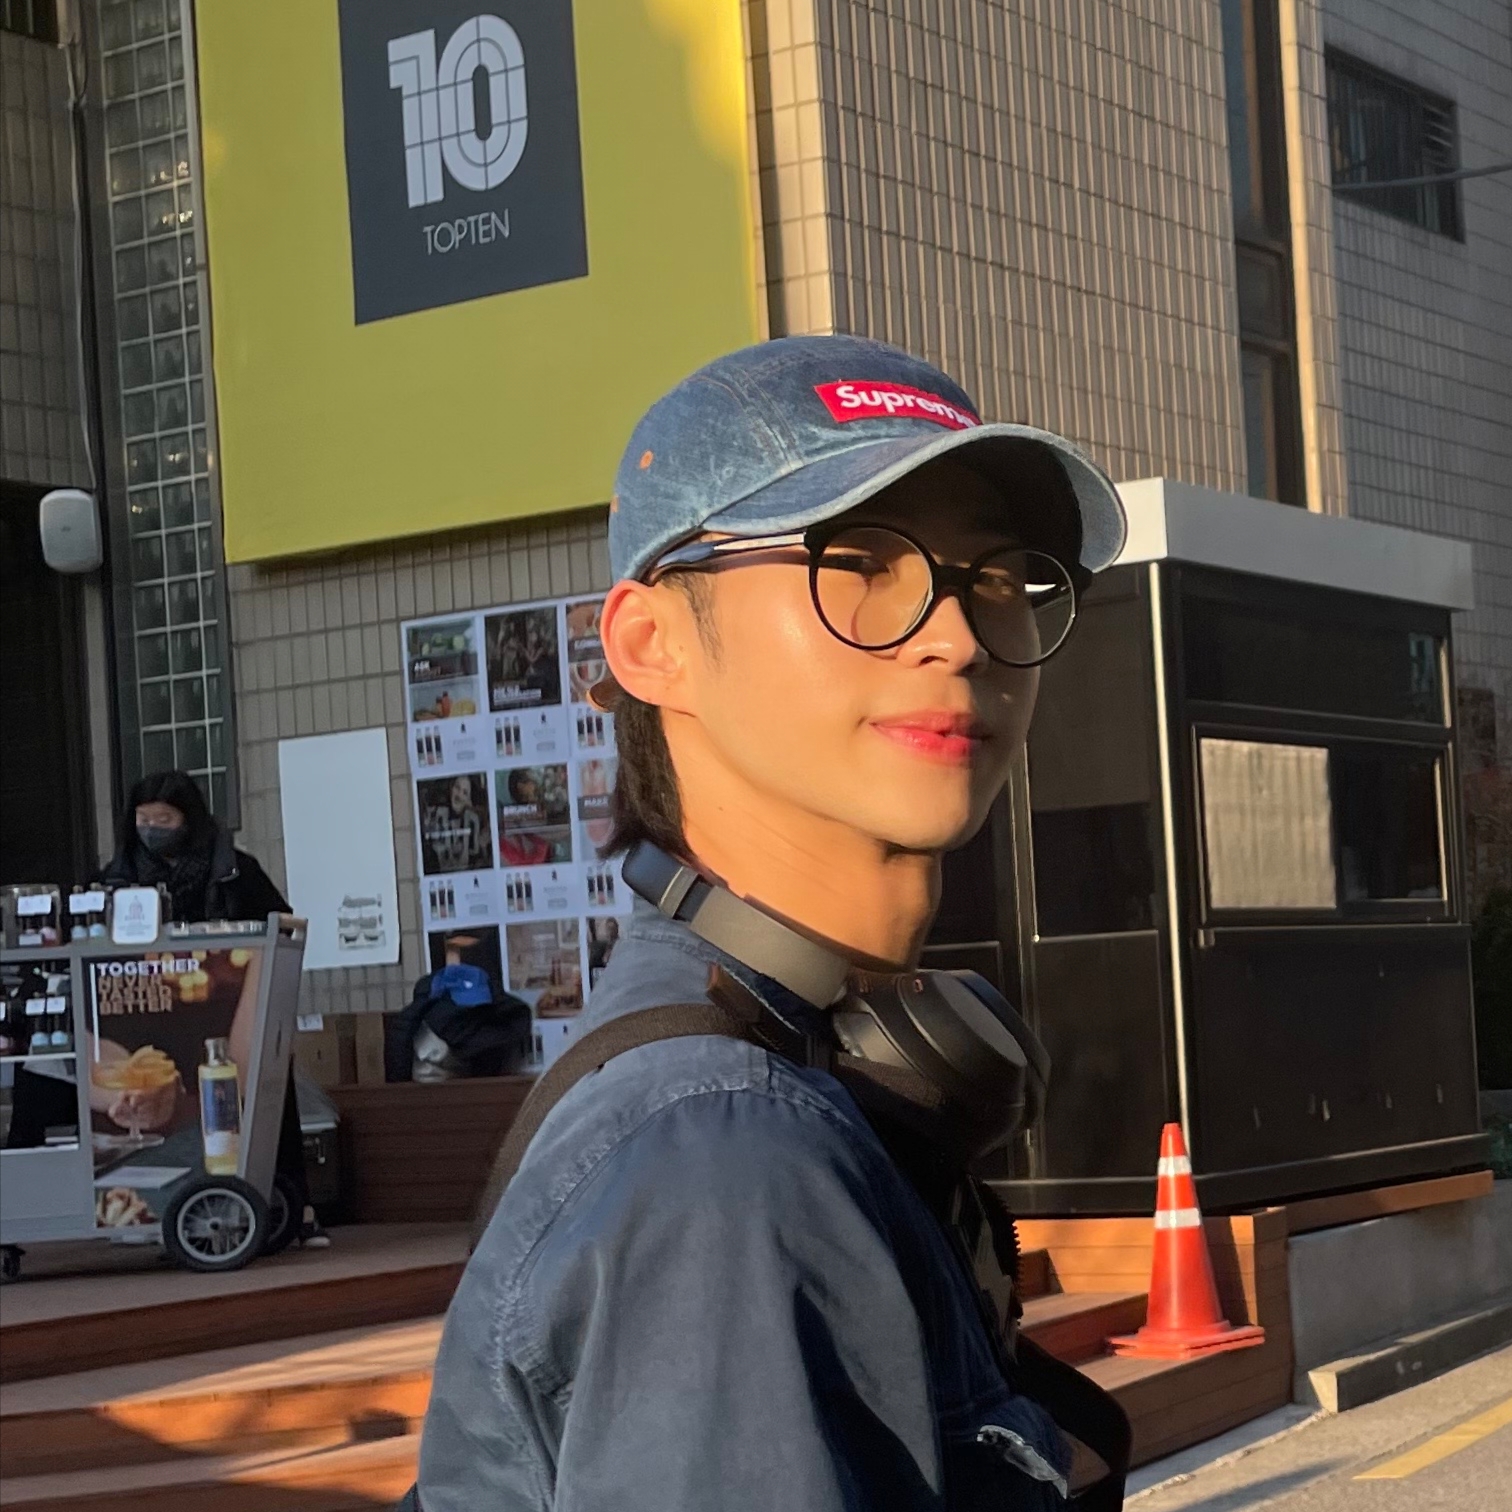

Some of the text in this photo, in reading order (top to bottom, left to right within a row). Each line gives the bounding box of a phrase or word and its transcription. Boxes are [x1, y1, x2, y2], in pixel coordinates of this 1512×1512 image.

[388, 14, 528, 208] 10
[423, 208, 510, 255] TOPTEN
[97, 959, 200, 976] TOGETHER
[98, 974, 162, 991] NEVER
[99, 986, 172, 1003] TASTED
[100, 998, 173, 1015] BETTER
